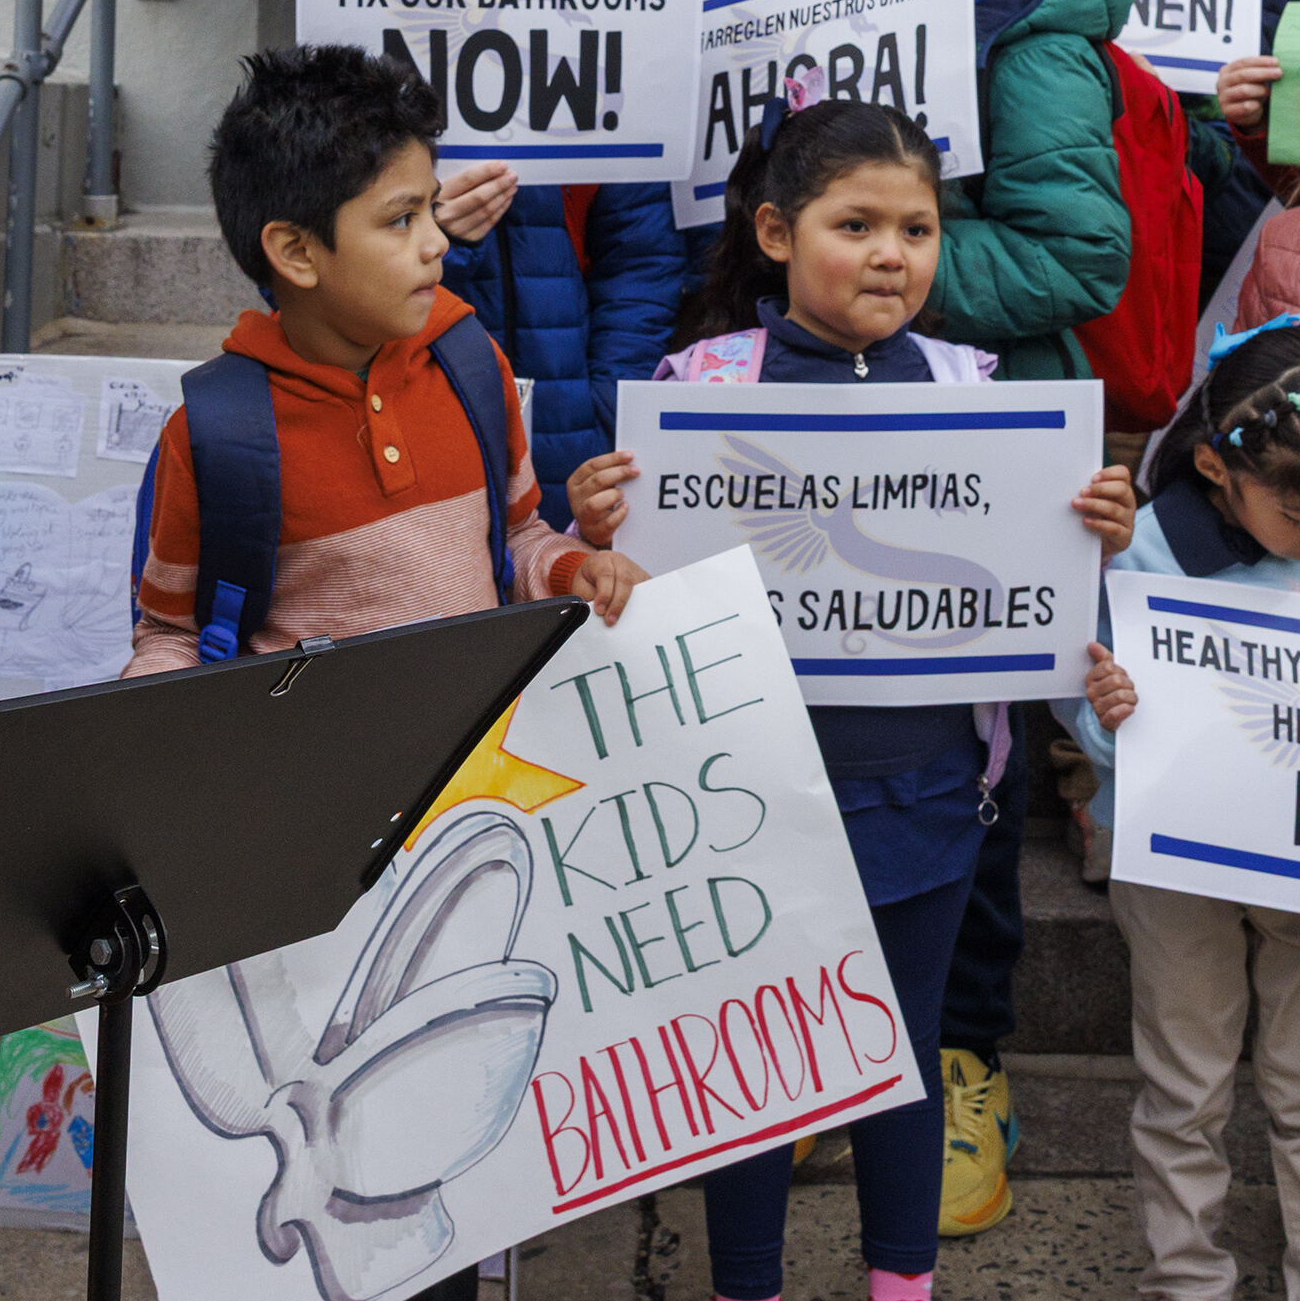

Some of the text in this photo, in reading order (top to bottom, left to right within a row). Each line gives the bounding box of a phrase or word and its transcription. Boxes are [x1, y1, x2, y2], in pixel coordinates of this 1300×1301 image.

[382, 28, 623, 132] NOW!
[701, 12, 785, 54] ¡ARREGLEN
[658, 473, 992, 516] ESCUELAS LIMPIAS,
[797, 586, 1056, 631] SALUDABLES
[551, 614, 764, 760] THE
[541, 753, 766, 907] KIDS
[566, 876, 772, 1013] NEED
[532, 950, 897, 1196] BATHROOMS
